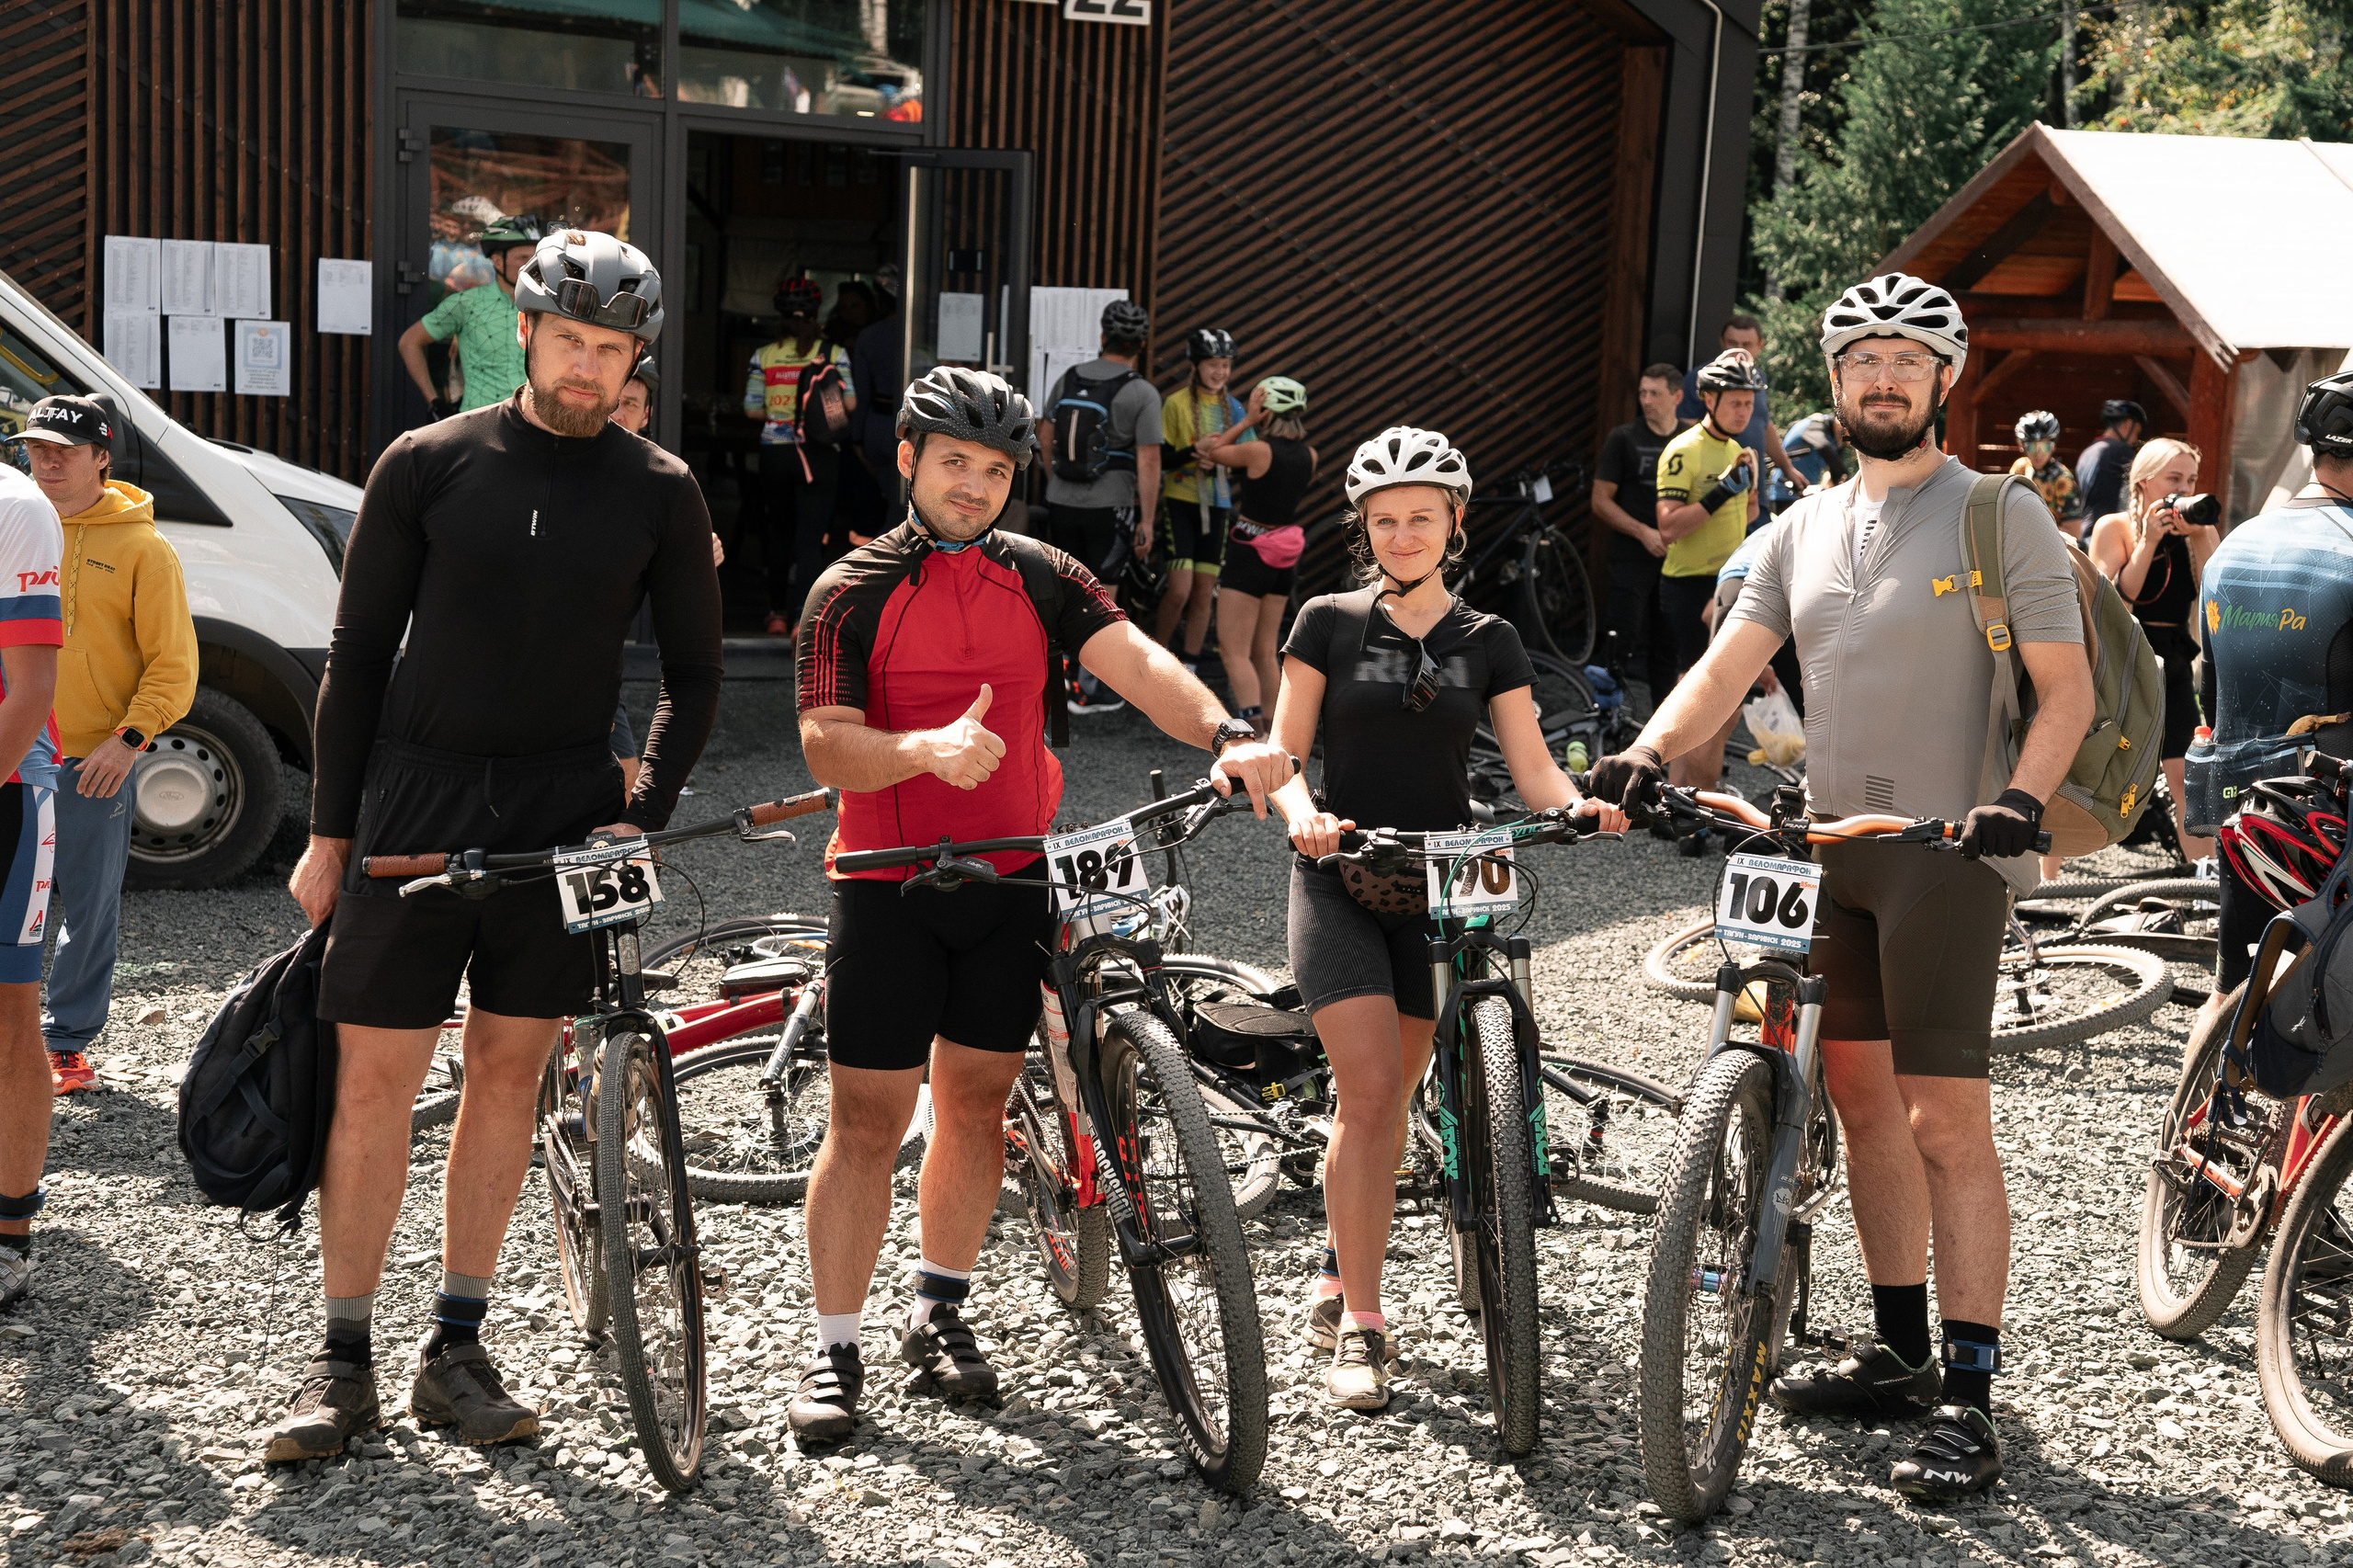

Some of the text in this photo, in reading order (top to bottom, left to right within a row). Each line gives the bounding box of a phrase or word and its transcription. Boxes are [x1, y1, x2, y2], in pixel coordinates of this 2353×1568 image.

[2325, 434, 2353, 444] LAZER
[530, 509, 539, 537] BTWIN
[1445, 835, 1504, 847] ВЕЛОМРАФОН
[1054, 842, 1134, 901] 189
[1432, 855, 1511, 898] 190
[1748, 858, 1812, 875] ВЕЛОМАРАФОН
[565, 864, 651, 915] 158
[1729, 872, 1809, 929] 106
[634, 905, 653, 915] 202
[1492, 903, 1511, 912] 2025
[1780, 938, 1802, 949] 2025
[1441, 1126, 1459, 1182] FOX
[1736, 1340, 1767, 1446] MAXXIS
[1175, 1412, 1211, 1468] MAXXIS
[1923, 1468, 1972, 1485] NW
